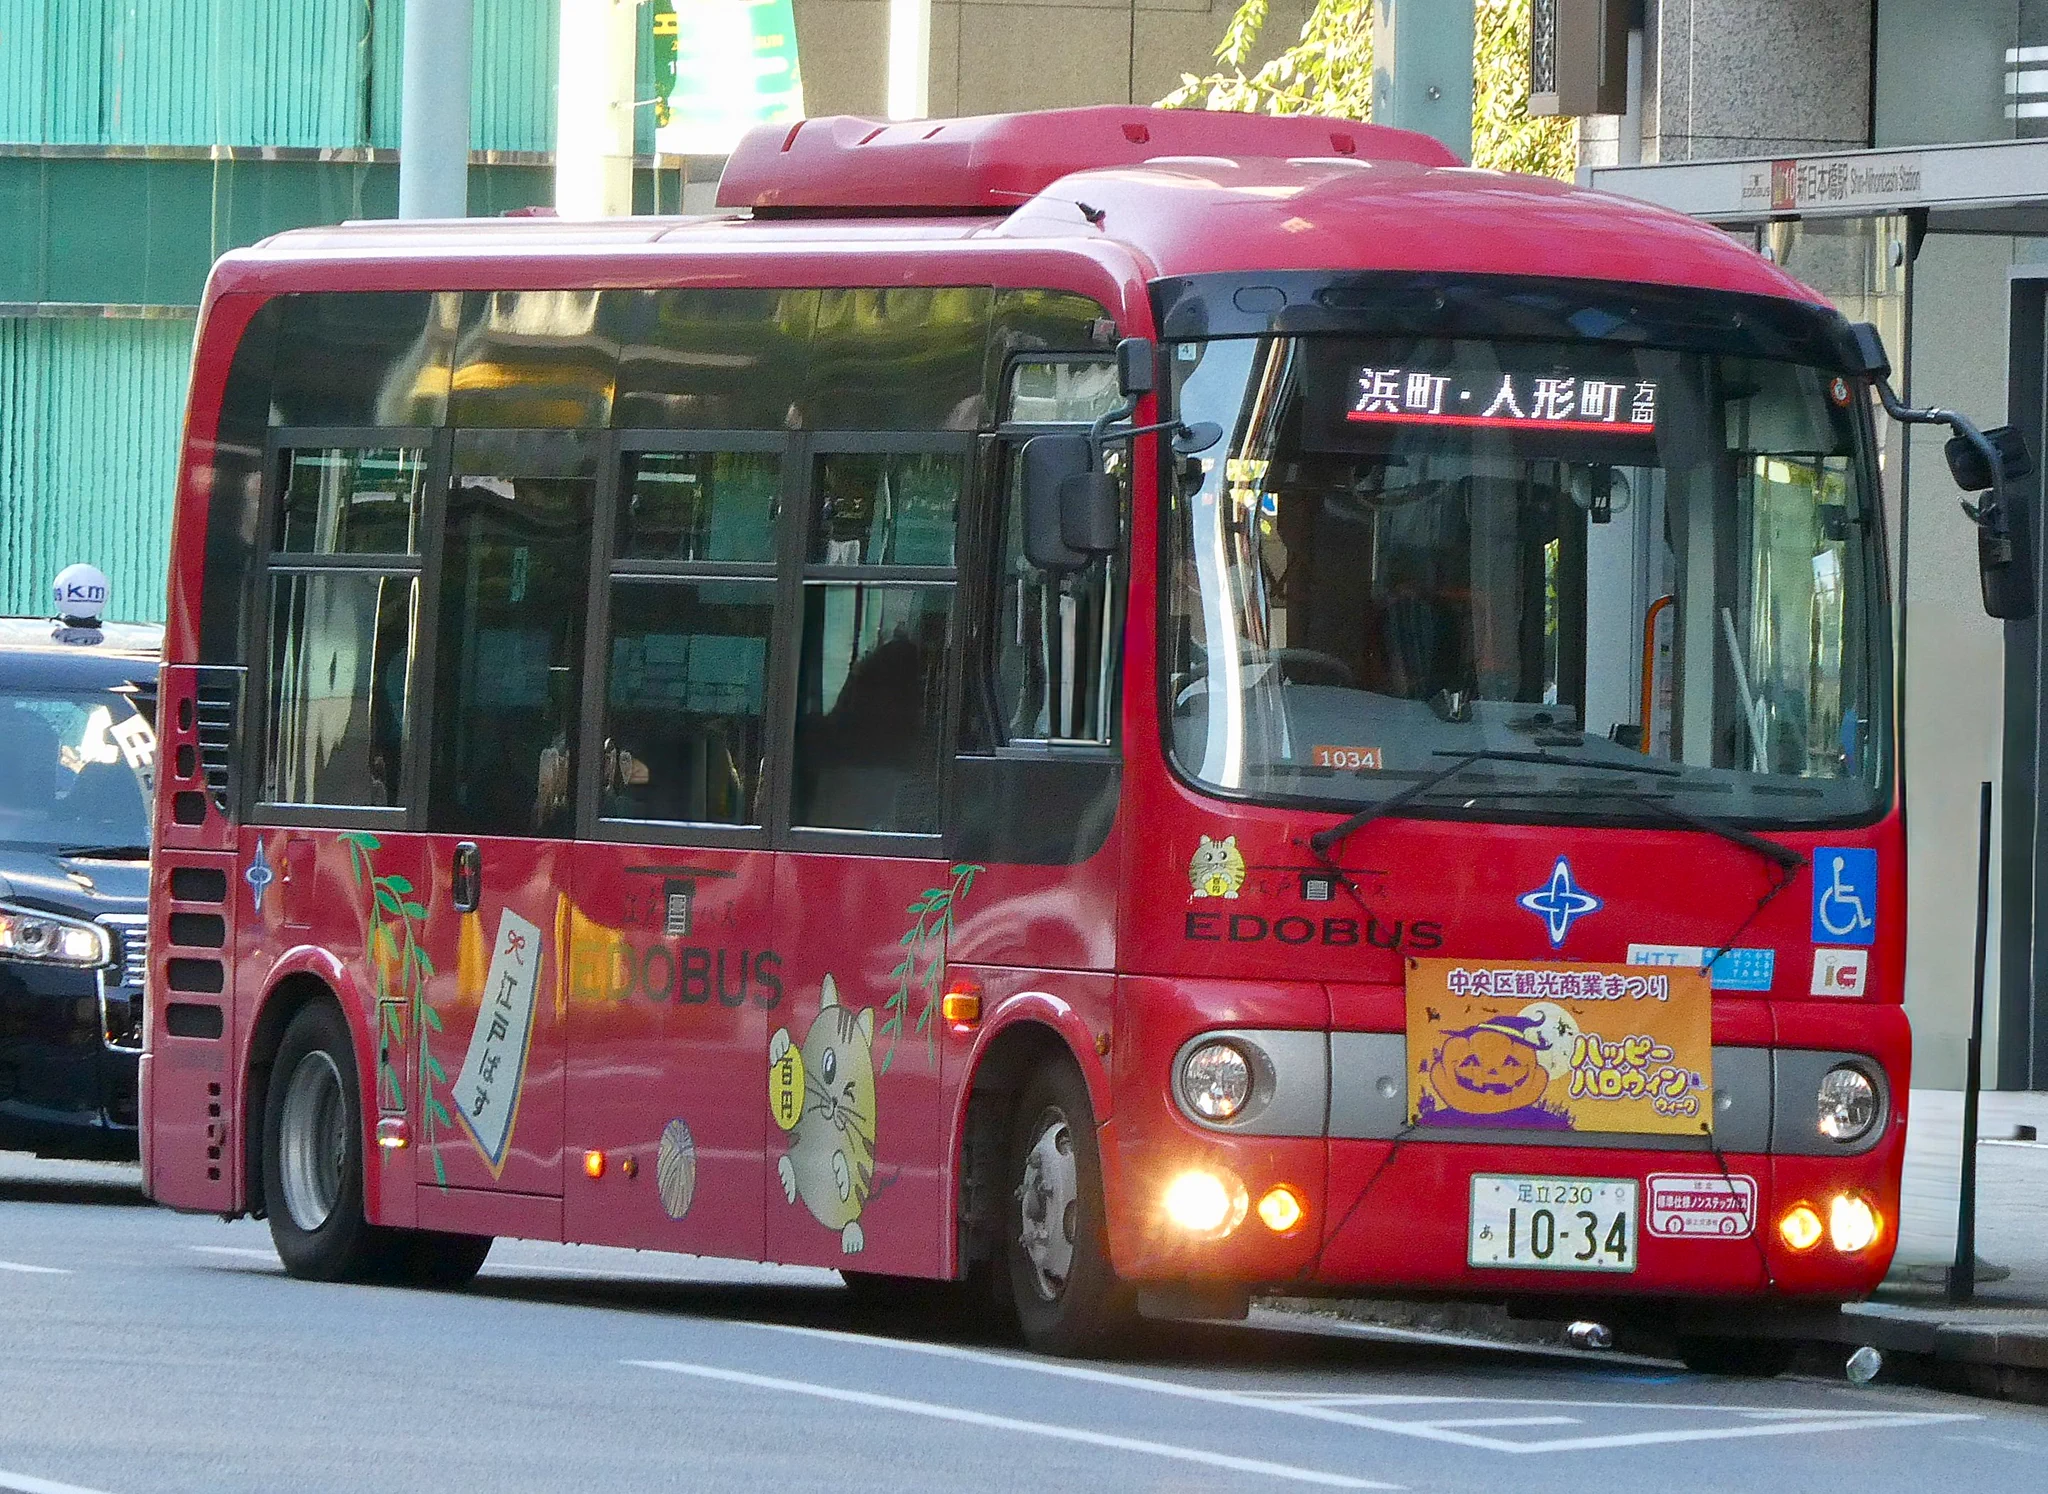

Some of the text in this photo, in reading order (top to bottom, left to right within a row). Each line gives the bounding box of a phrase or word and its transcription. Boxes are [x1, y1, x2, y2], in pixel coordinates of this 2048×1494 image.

[67, 582, 105, 599] km
[1321, 751, 1375, 768] 1034
[1184, 911, 1444, 950] EDOBUS
[1635, 951, 1680, 965] HTT
[573, 939, 785, 1011] EDOBUS
[1448, 968, 1669, 1001] 中央区観光商業まつり
[472, 970, 518, 1118] 江戸ばす
[1570, 1033, 1674, 1069] ハッピー
[1569, 1067, 1690, 1099] ハロウィン
[1653, 1096, 1699, 1116] ウィーク
[1479, 1208, 1627, 1262] あ 10-34
